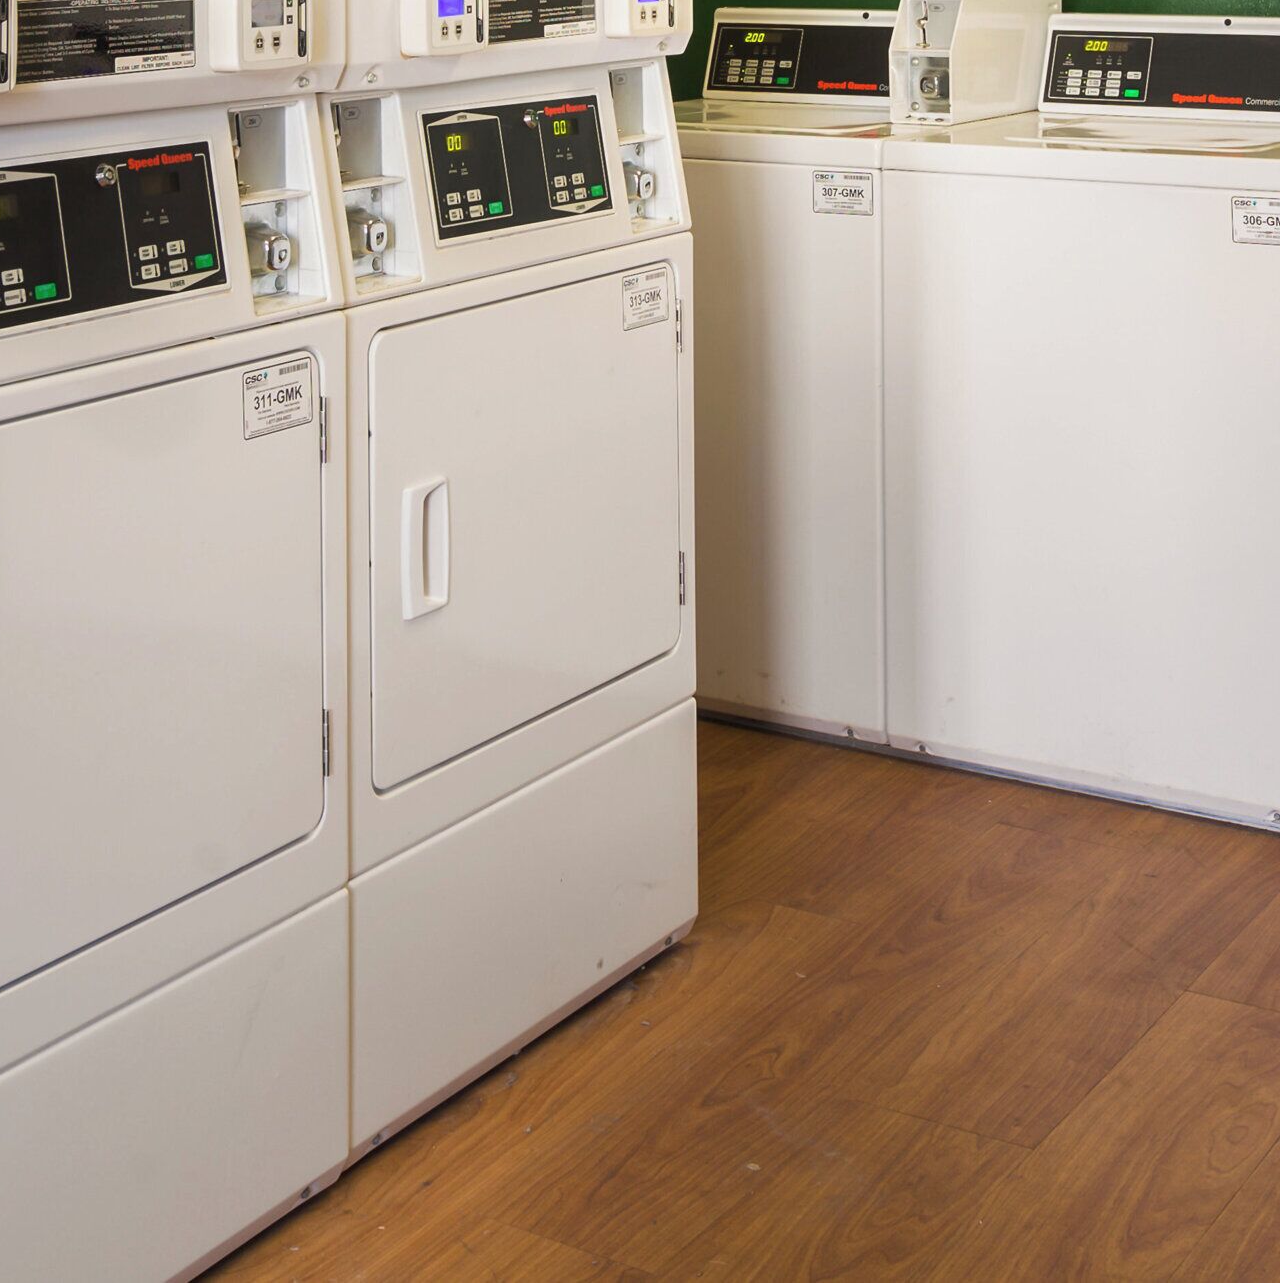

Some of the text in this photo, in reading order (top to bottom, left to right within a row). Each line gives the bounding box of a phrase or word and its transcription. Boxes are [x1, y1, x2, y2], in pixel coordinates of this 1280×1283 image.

[745, 32, 765, 43] 2.00
[1085, 41, 1108, 51] 2.00
[817, 80, 847, 91] Speed
[1172, 93, 1207, 104] Speed
[127, 152, 193, 171] Speed Queen
[822, 188, 864, 198] 307-GMK
[629, 289, 662, 308] 313-GMK
[245, 373, 263, 385] CSC
[254, 385, 303, 410] 311-GMK
